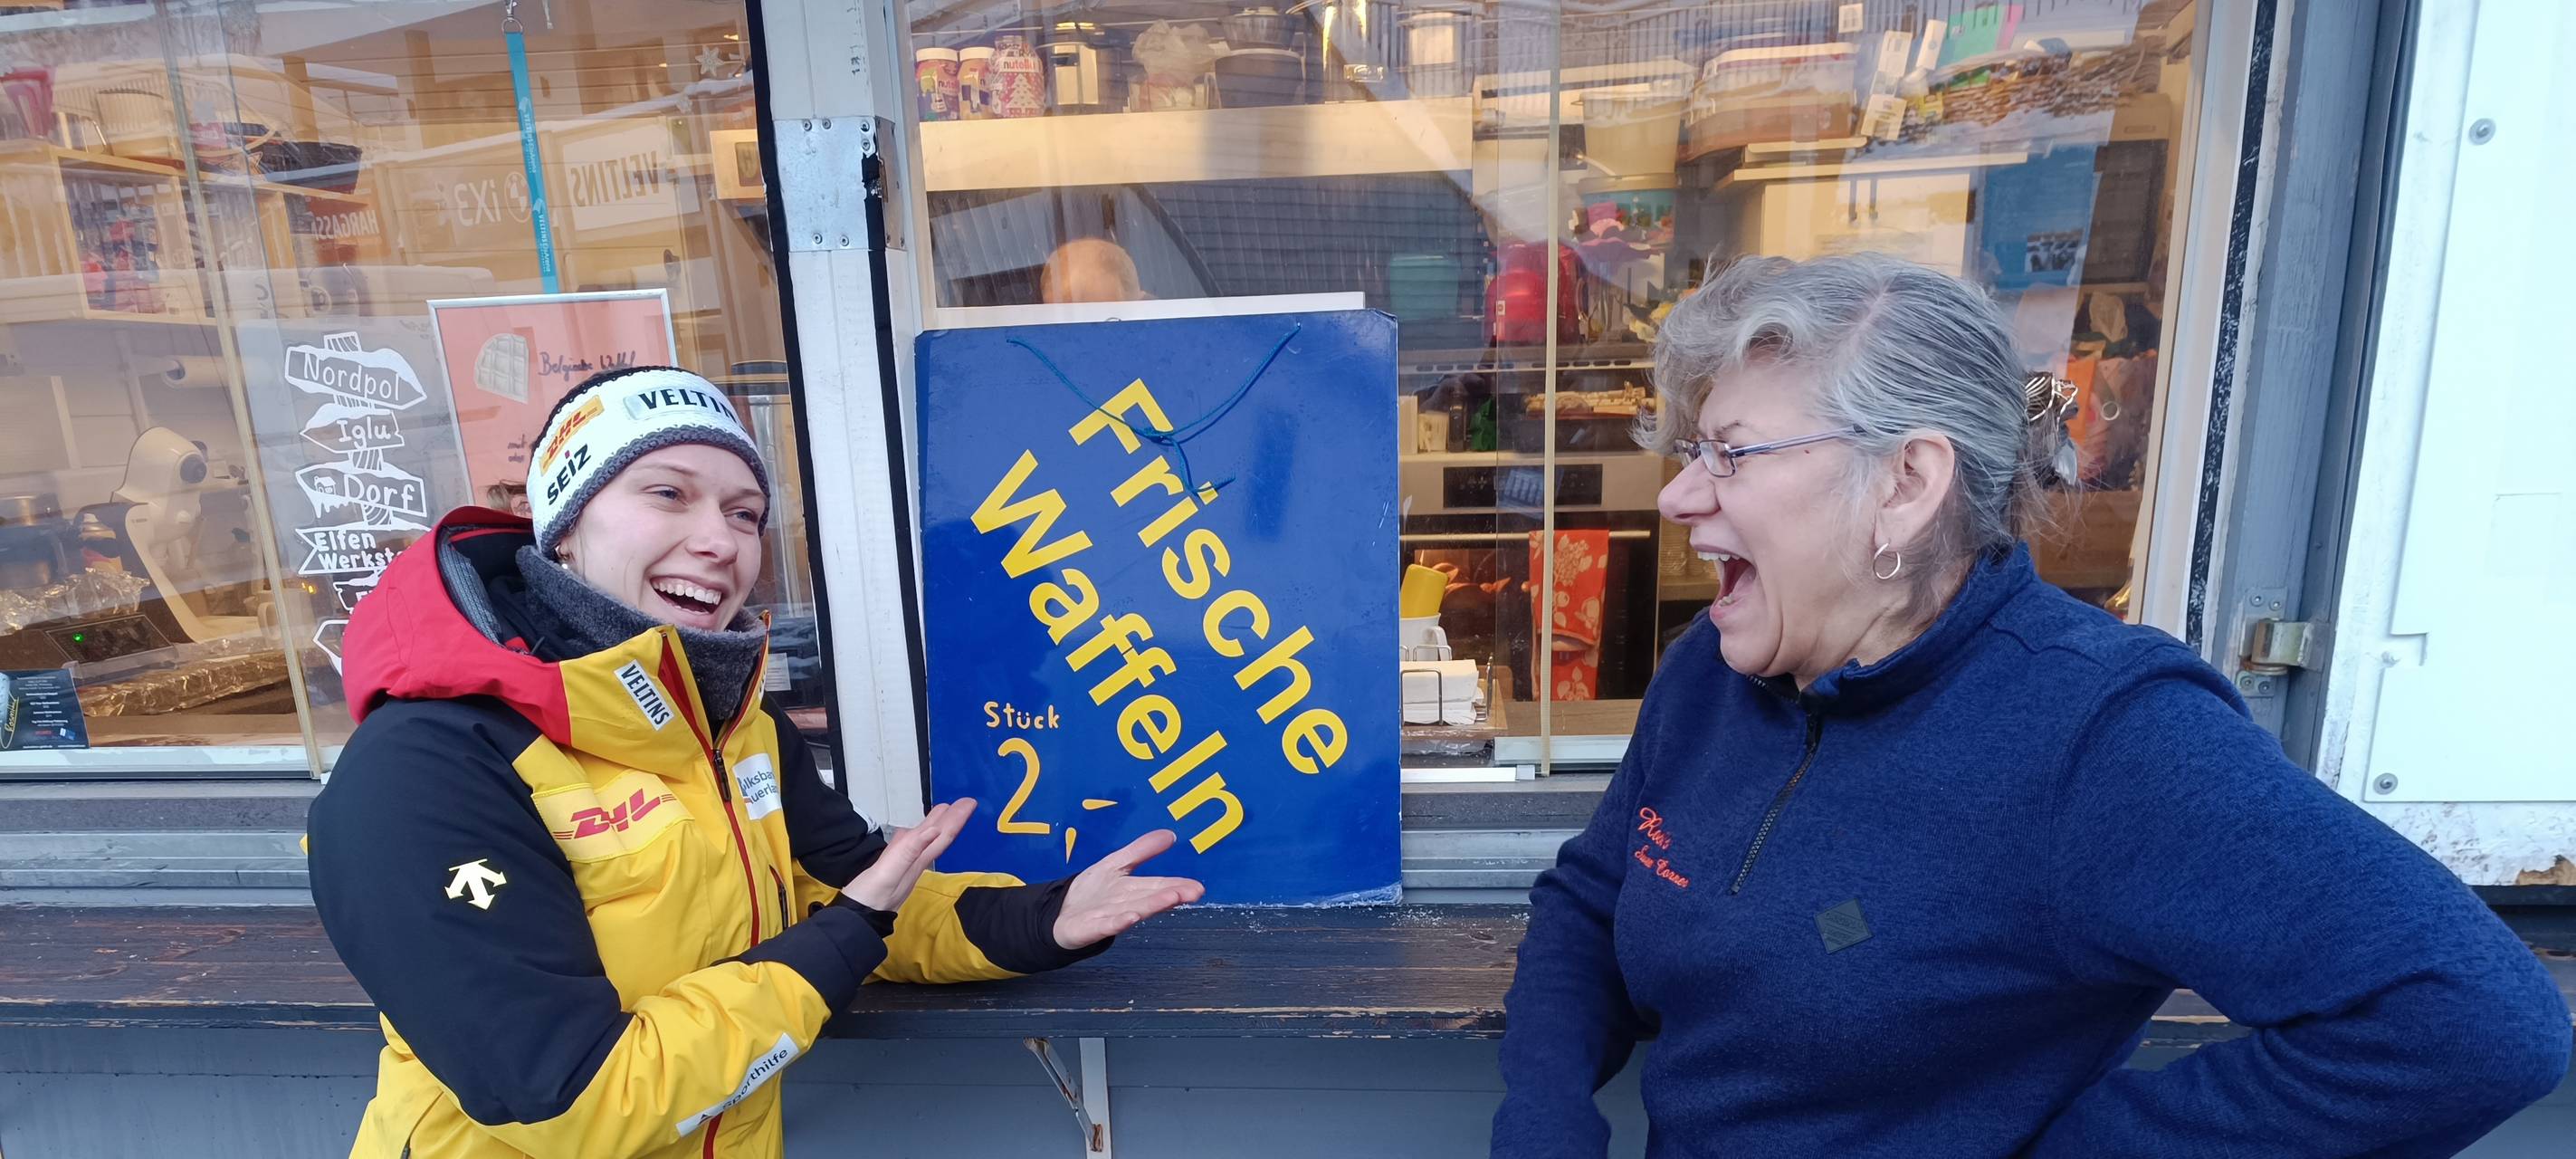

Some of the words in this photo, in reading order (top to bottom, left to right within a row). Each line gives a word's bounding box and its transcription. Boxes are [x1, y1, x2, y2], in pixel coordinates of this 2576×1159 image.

[303, 351, 399, 401] Nordpol
[336, 416, 392, 449] Iglu
[547, 411, 587, 459] DHL
[638, 388, 747, 434] VELTIN
[344, 474, 415, 509] Dorf
[313, 529, 377, 552] Elfen
[1068, 378, 1348, 774] Frische
[970, 449, 1244, 854] Waffeln
[621, 664, 670, 725] VELTINS
[984, 701, 1060, 730] Stück
[570, 788, 661, 839] DHL
